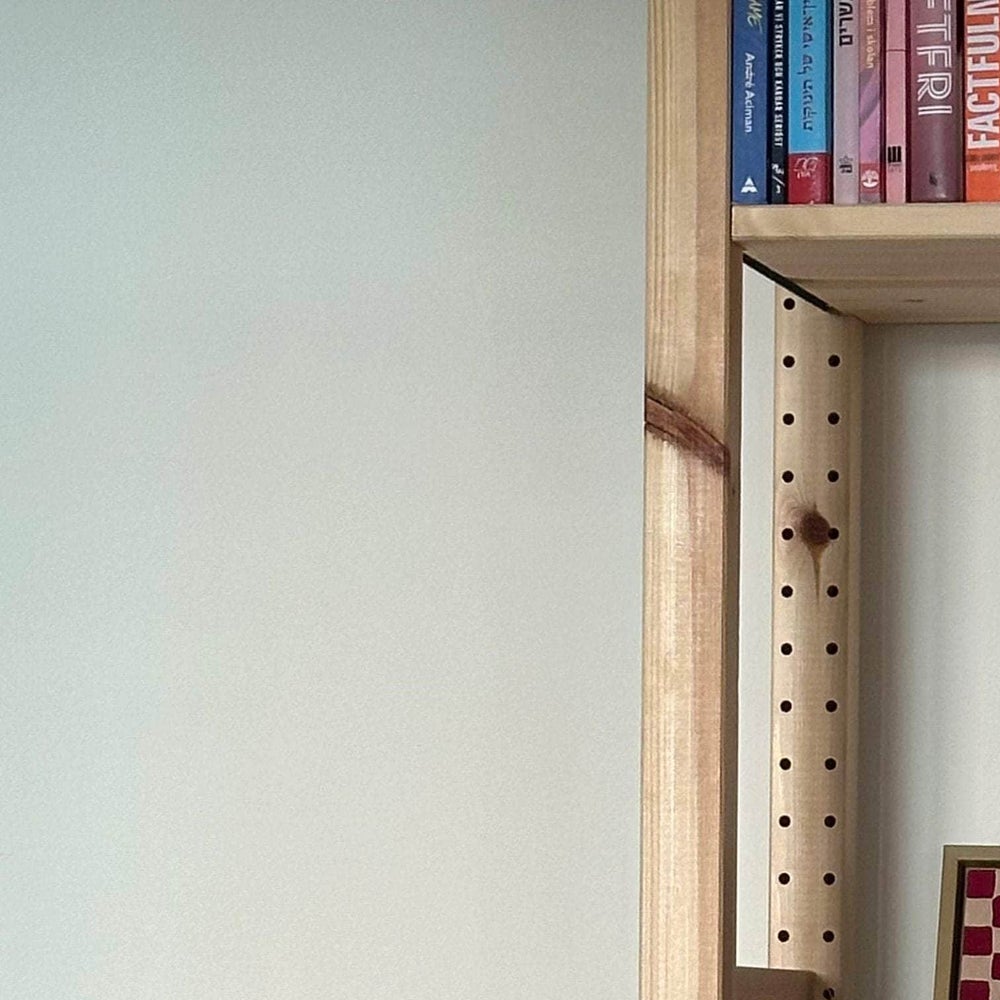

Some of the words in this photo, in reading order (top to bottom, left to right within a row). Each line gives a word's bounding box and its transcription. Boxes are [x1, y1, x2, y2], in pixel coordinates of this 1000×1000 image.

[838, 0, 853, 46] שרים
[797, 55, 813, 75] של
[866, 34, 877, 69] skolan
[744, 52, 756, 89] André
[744, 90, 756, 133] Aciman
